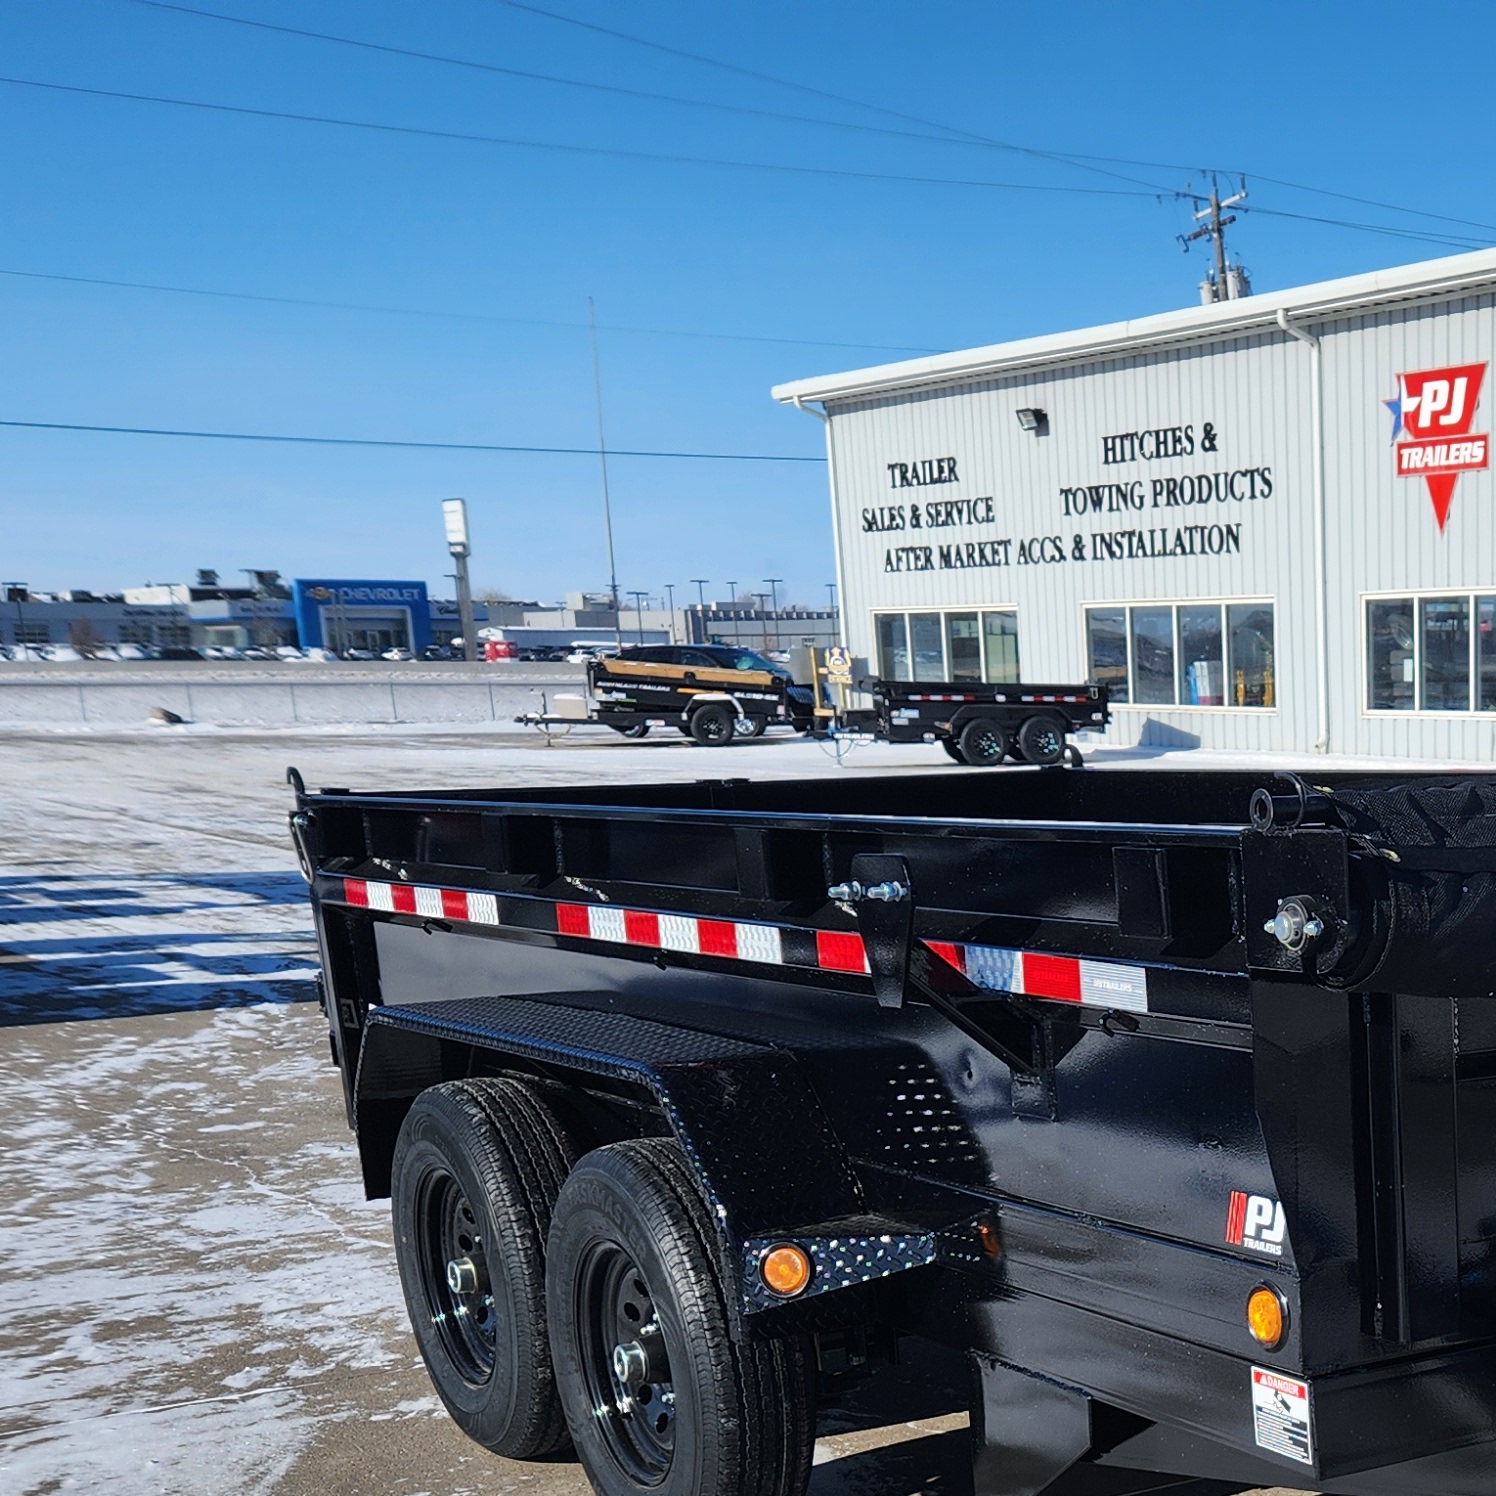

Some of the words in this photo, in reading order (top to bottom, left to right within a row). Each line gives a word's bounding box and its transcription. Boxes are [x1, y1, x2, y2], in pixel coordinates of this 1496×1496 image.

[1418, 377, 1468, 428] PJ
[1101, 425, 1195, 465] HITCHES
[1201, 422, 1218, 452] &
[1400, 440, 1486, 470] TRAILERS
[887, 457, 959, 489] TRAILER
[1060, 480, 1145, 516] TOWING
[1150, 467, 1273, 508] PRODUCTS
[862, 505, 905, 533] SALES
[910, 504, 923, 529] &
[925, 497, 995, 528] SERVICE
[884, 546, 935, 573] AFTER
[938, 539, 1012, 570] MARKET
[1071, 533, 1086, 561] &
[1091, 523, 1243, 561] INSTALLATION
[343, 587, 421, 600] CHEVROLET
[1244, 1195, 1286, 1243] PJ
[1243, 1237, 1282, 1256] TRAILERS
[1266, 1375, 1299, 1396] DANGER
